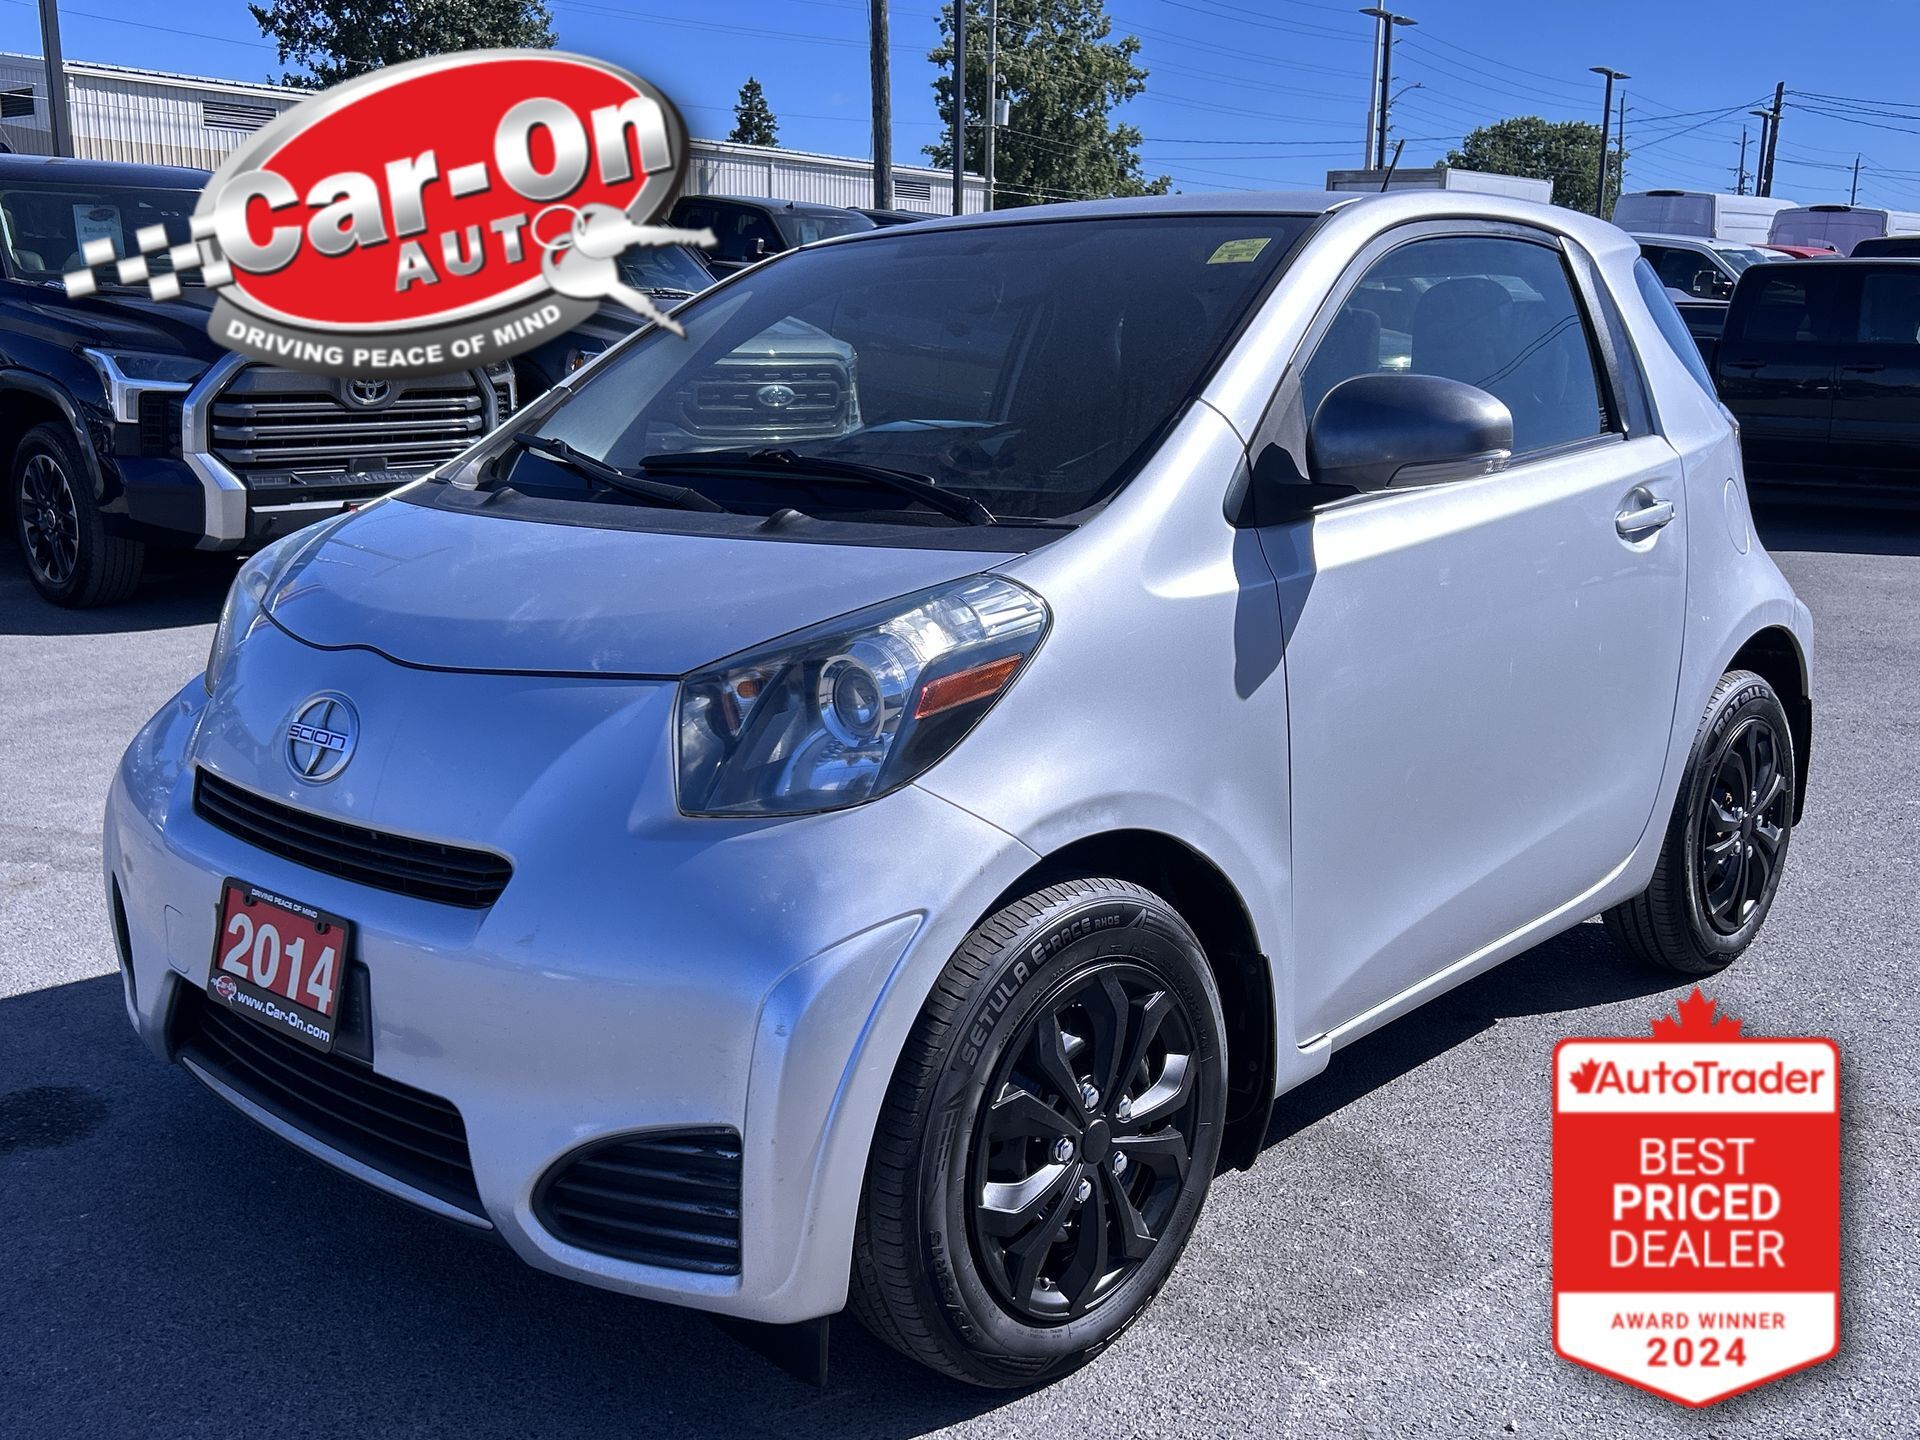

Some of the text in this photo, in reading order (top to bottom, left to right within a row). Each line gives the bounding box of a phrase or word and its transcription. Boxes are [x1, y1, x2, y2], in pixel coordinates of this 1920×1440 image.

[251, 888, 318, 919] DRIVING PEACE OF MIND
[222, 912, 335, 1014] 2014
[960, 961, 1031, 1066] SETULA
[1031, 917, 1091, 966] E-RACE
[237, 991, 330, 1042] www.Car-On.com
